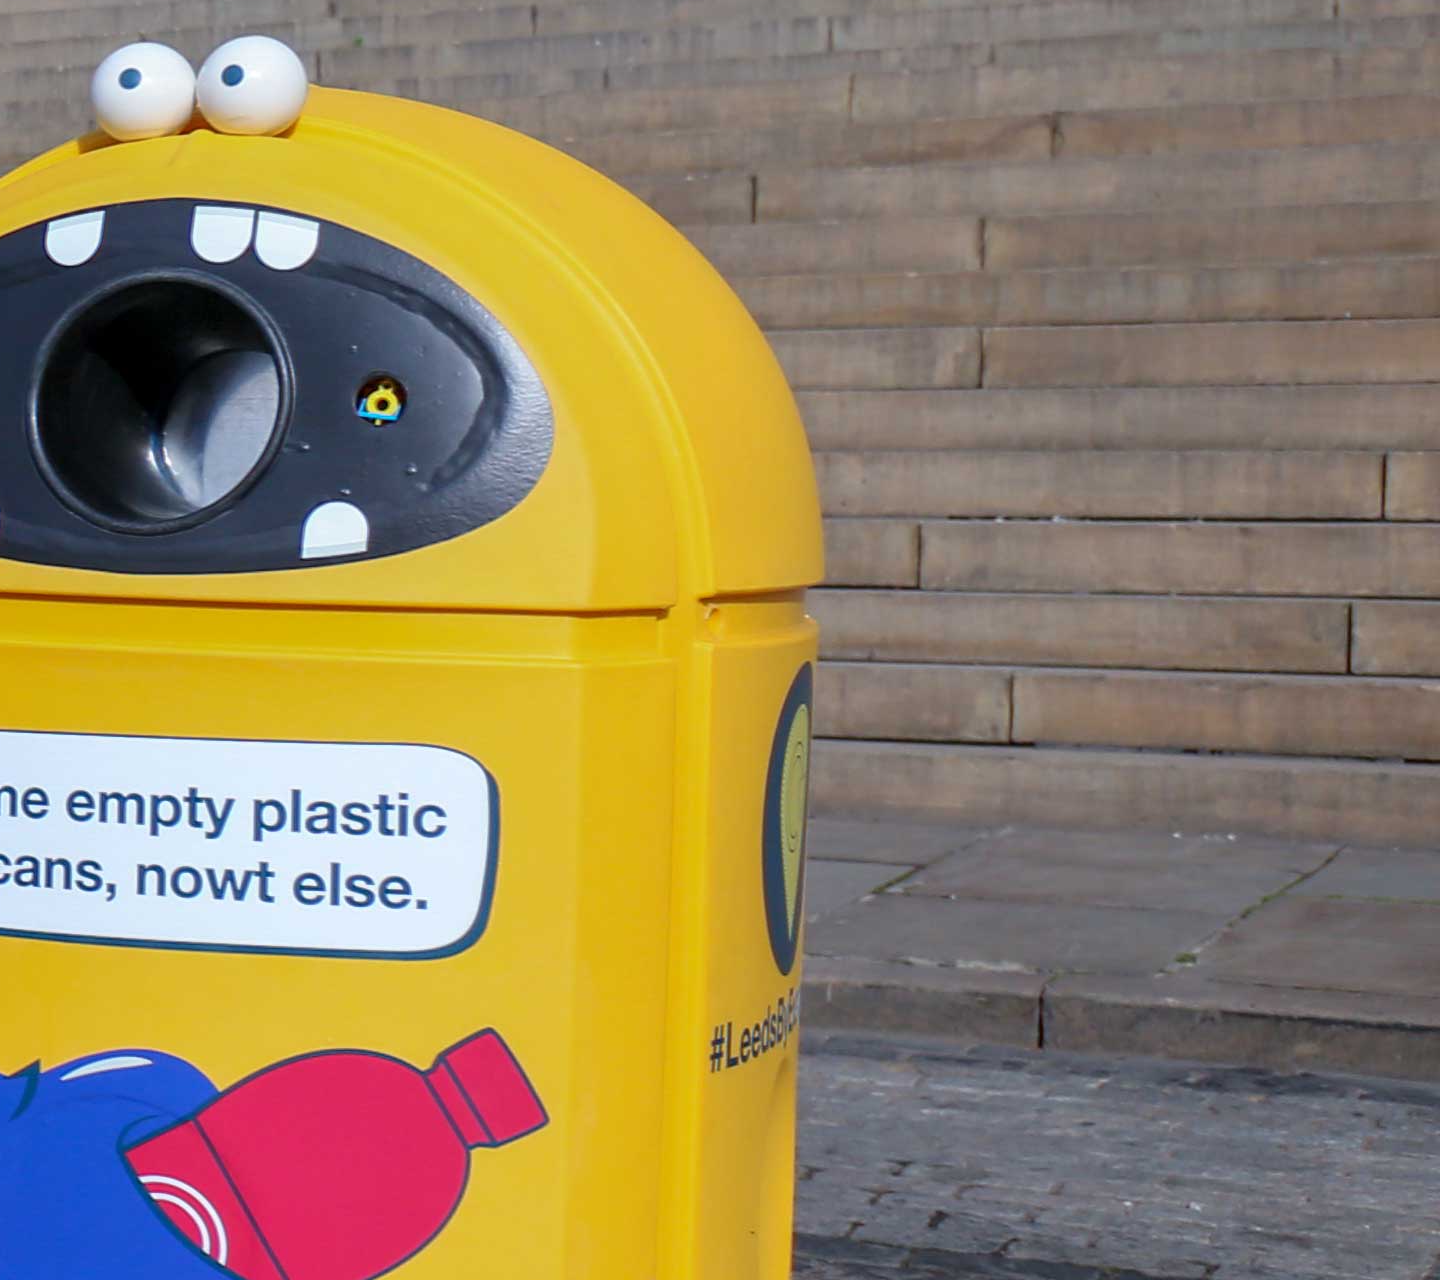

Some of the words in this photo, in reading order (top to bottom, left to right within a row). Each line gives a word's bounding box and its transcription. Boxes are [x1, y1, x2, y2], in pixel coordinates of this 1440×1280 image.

[65, 787, 234, 839] empty
[252, 789, 448, 841] plastic
[135, 858, 275, 903] nowt
[293, 863, 429, 911] else.
